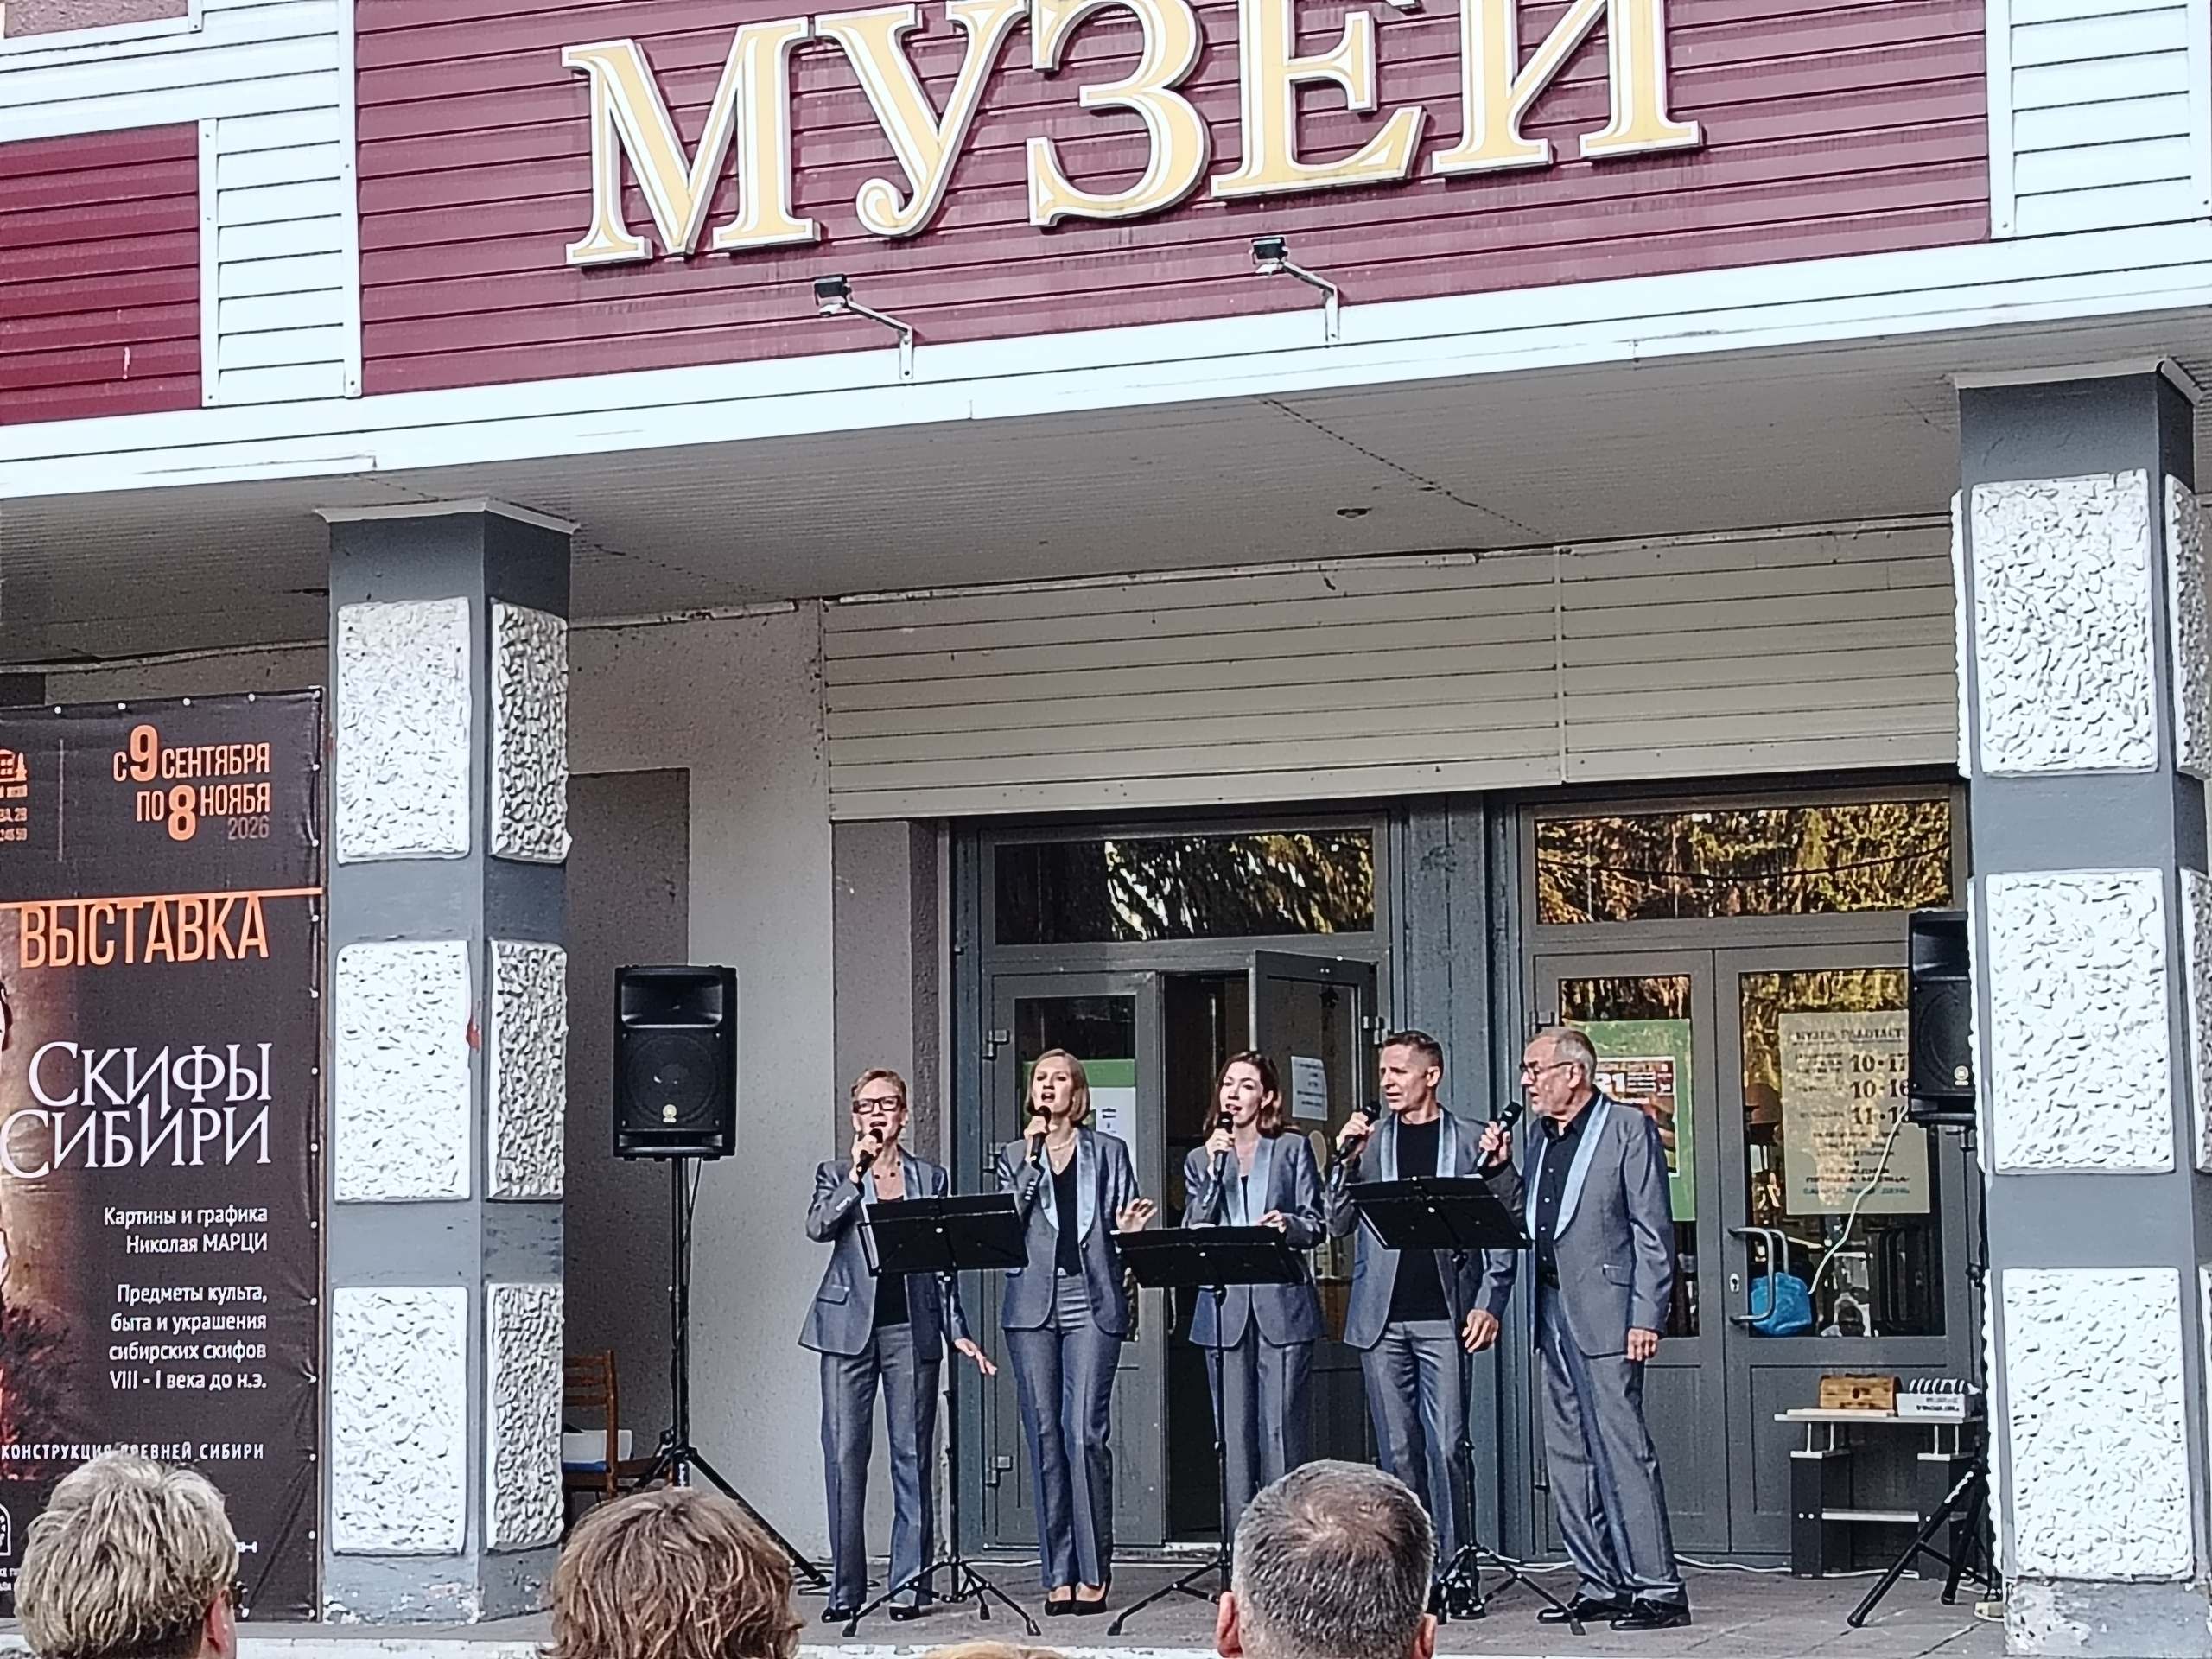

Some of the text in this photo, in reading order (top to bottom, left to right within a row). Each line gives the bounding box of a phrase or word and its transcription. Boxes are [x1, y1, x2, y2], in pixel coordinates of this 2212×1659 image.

[130, 724, 158, 782] 9
[162, 742, 270, 779] СЕНТЯБРЯ
[137, 791, 165, 822] ПО
[168, 785, 197, 841] 8
[227, 815, 270, 841] 2026
[20, 893, 270, 969] ВЫСТАВКА
[104, 1204, 268, 1230] Картины и графика
[126, 1232, 268, 1254] Николая МАРЦИ
[117, 1284, 268, 1306] Предметы культа,
[111, 1313, 267, 1335] быта и украшения
[109, 1339, 267, 1364] сибирских скифов
[109, 1370, 138, 1389] VIII
[166, 1373, 206, 1389] века
[208, 1373, 232, 1391] до
[237, 1372, 268, 1389] н.э.
[199, 1444, 264, 1459] СИБИРИ
